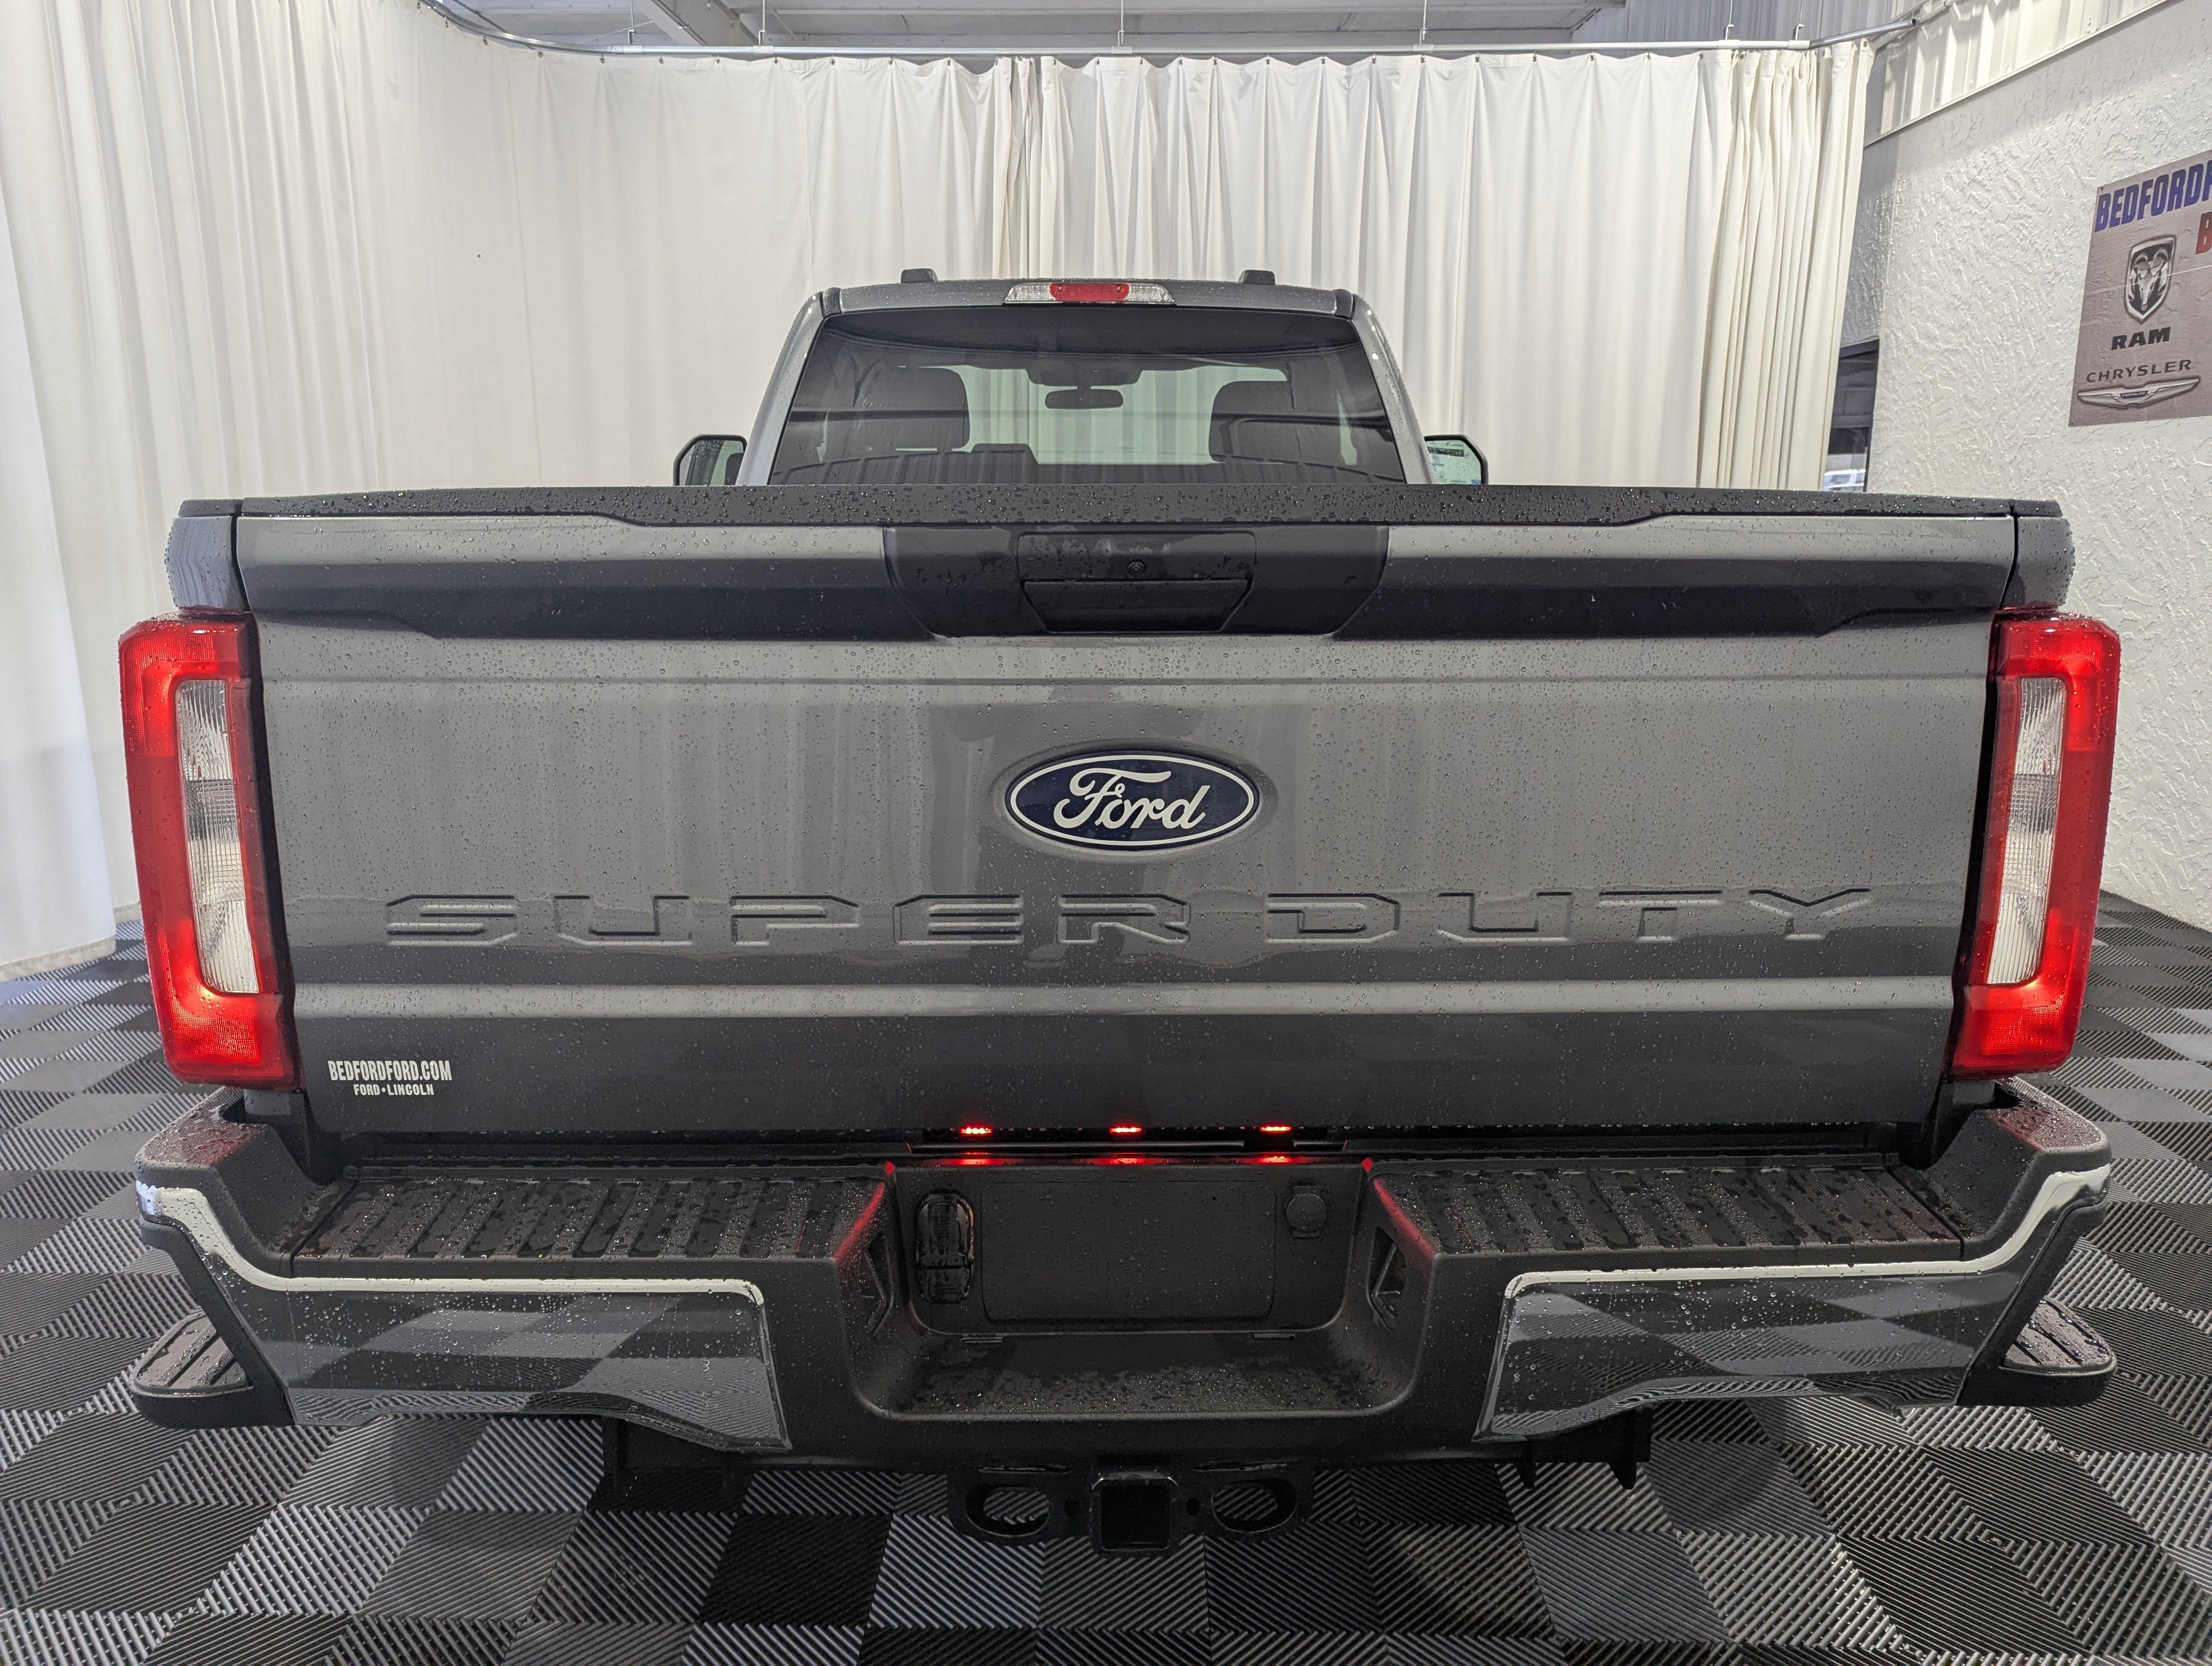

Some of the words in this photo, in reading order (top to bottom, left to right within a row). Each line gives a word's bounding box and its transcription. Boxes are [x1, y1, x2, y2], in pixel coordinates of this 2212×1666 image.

[2111, 326, 2171, 351] RAM
[2086, 358, 2192, 383] CHRYSLER
[1053, 767, 1211, 829] Ford
[385, 894, 1191, 948] SUPER
[1266, 887, 1873, 944] DUTY
[327, 1060, 452, 1081] BEDFORDFORD.COM
